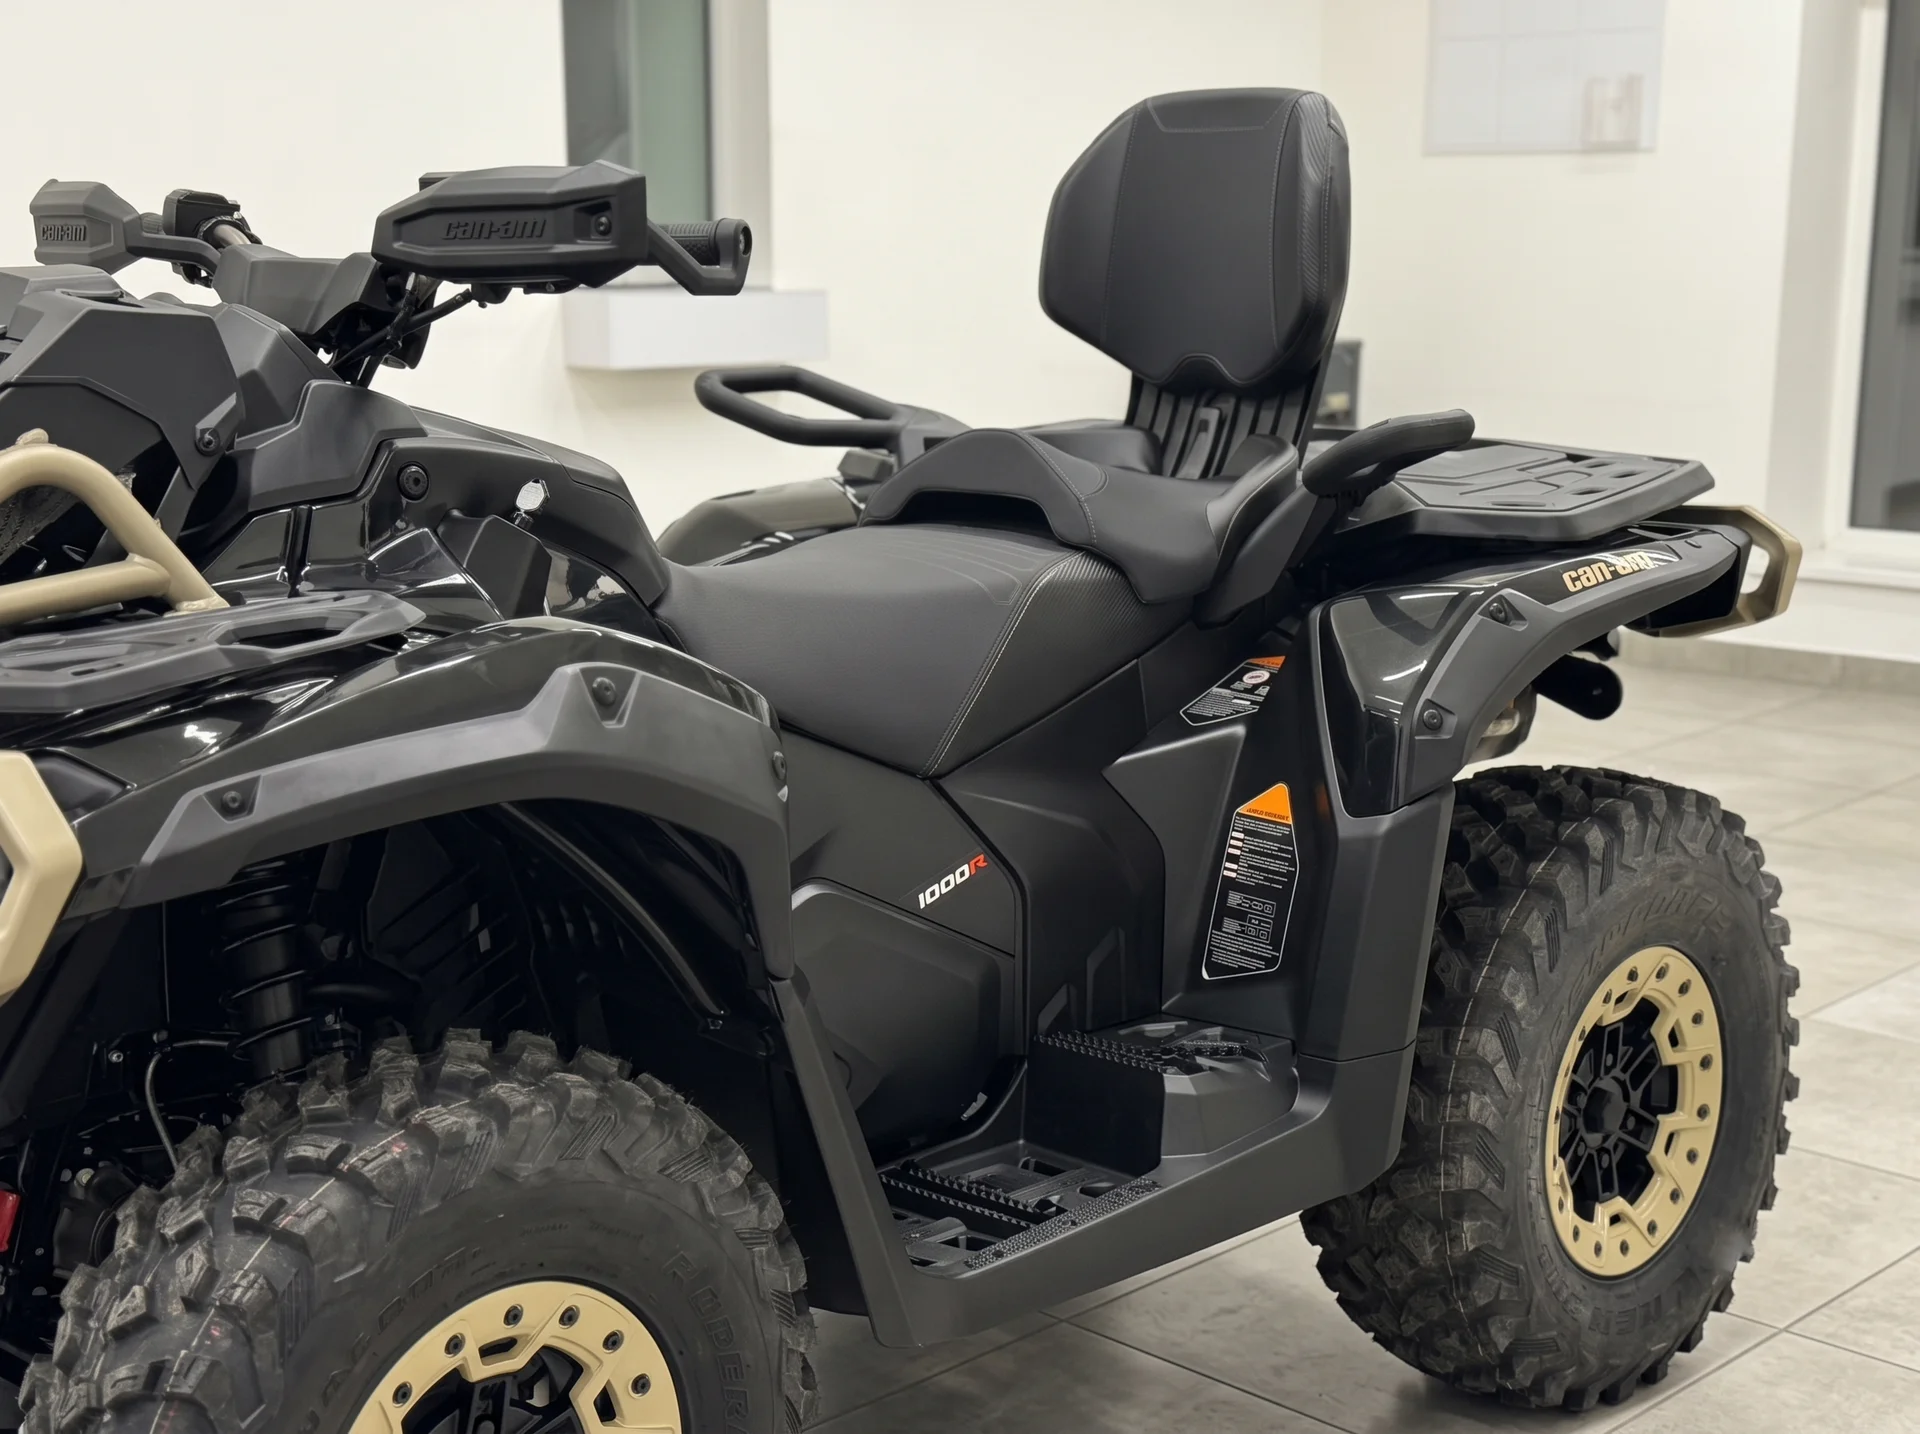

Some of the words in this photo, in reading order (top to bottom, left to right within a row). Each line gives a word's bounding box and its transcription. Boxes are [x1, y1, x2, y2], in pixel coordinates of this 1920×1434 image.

[40, 224, 87, 241] can-am
[441, 219, 547, 240] can-am
[918, 853, 988, 910] 1000R
